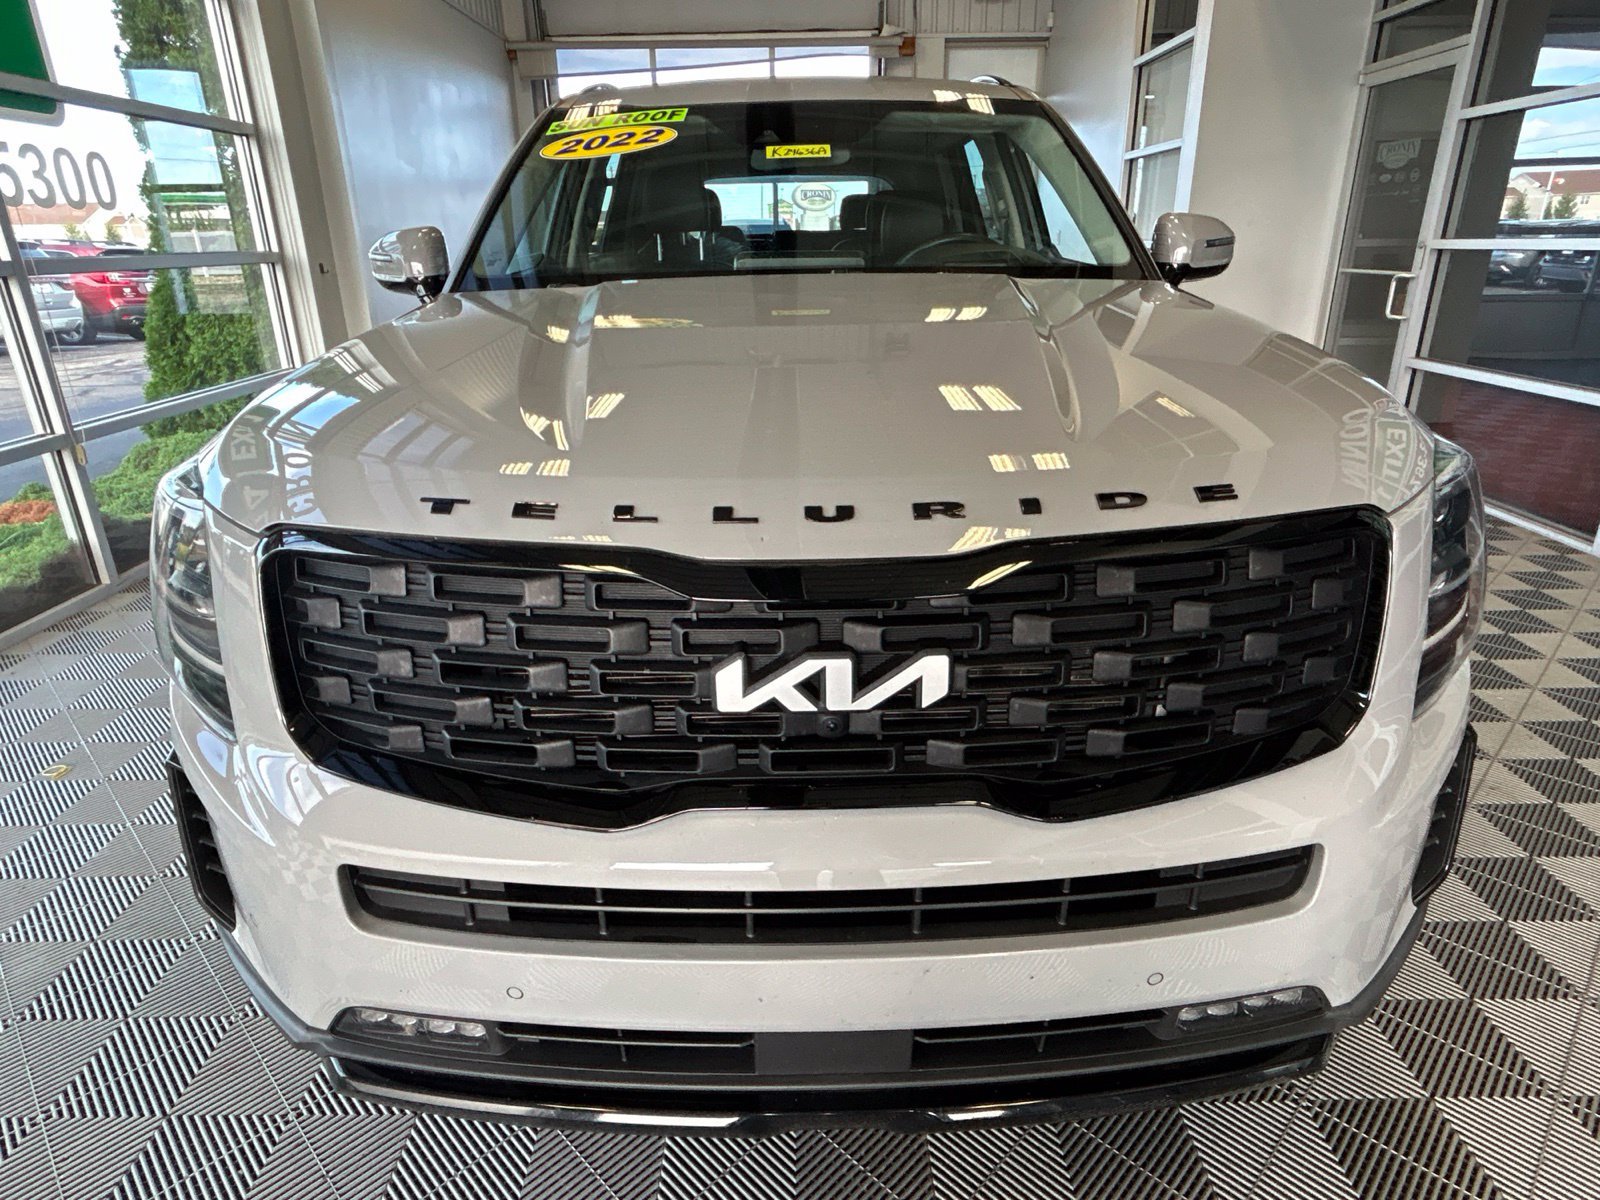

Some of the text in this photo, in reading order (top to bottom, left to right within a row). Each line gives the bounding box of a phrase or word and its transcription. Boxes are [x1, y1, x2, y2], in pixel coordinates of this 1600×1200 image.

[550, 109, 685, 132] SUN ROOF
[554, 128, 666, 156] 2022
[0, 141, 117, 210] 5300
[801, 189, 831, 200] CRONIN
[420, 483, 1239, 524] TELLURIDE
[715, 653, 949, 714] KIA
